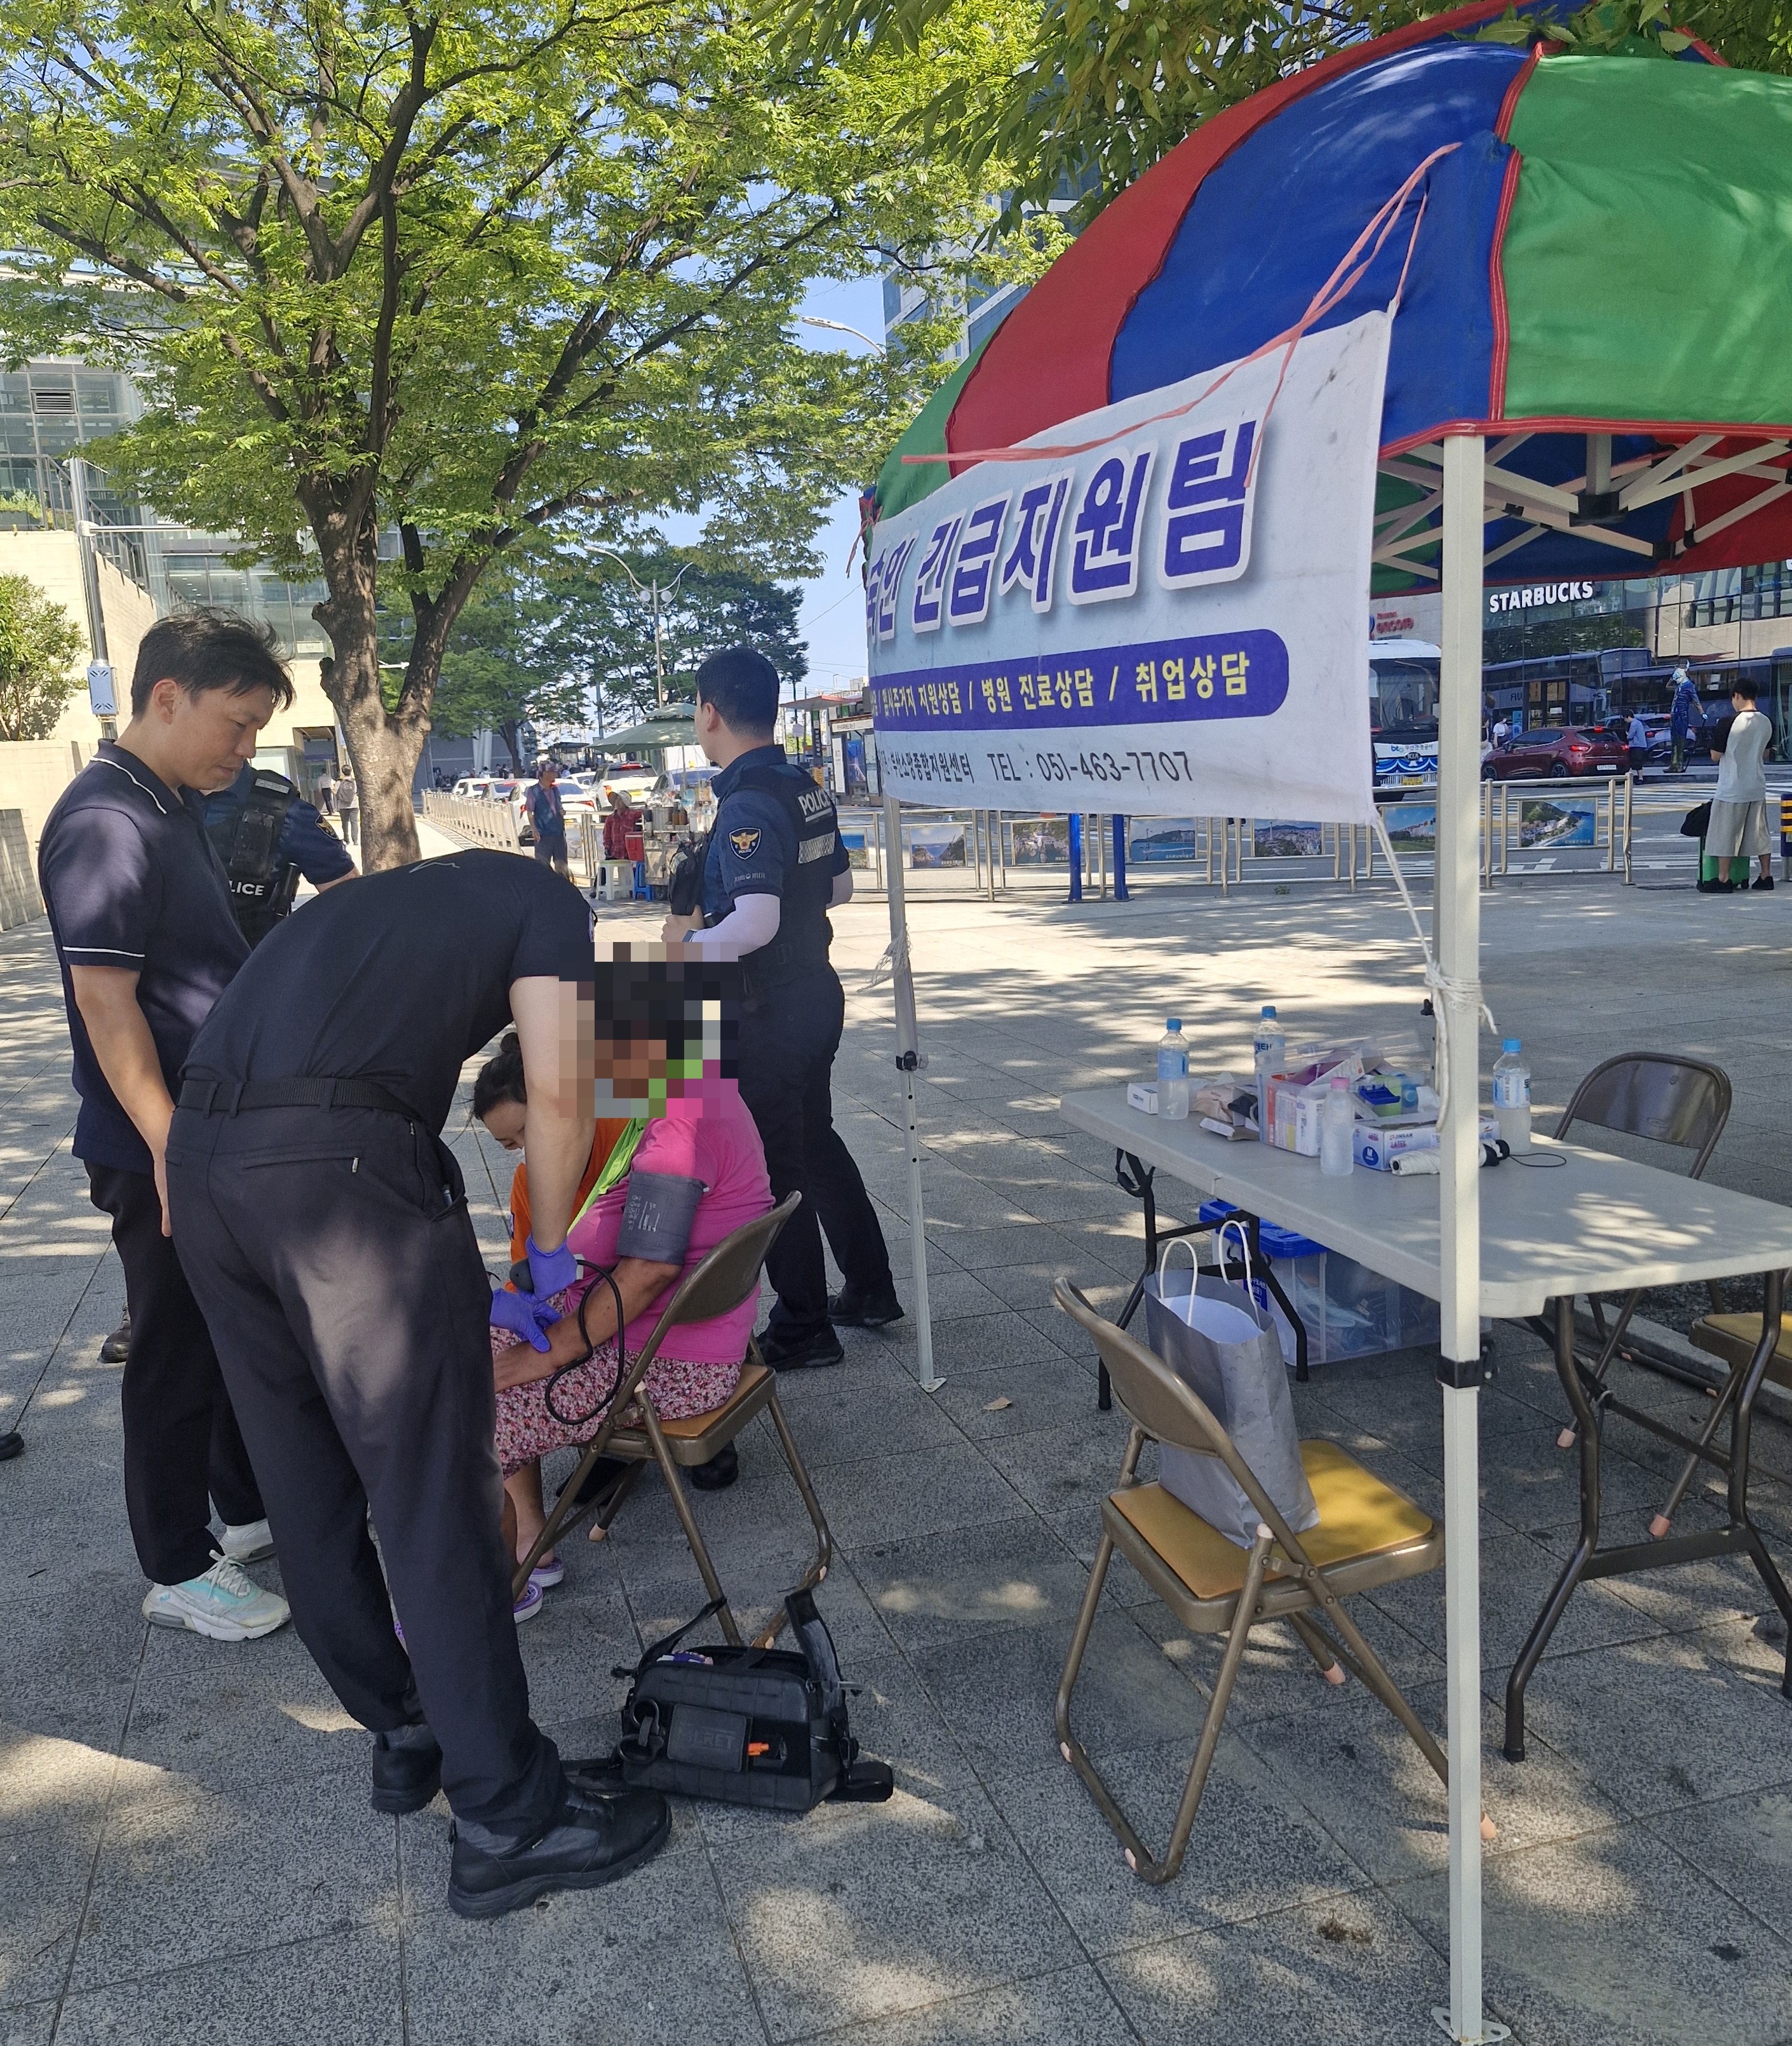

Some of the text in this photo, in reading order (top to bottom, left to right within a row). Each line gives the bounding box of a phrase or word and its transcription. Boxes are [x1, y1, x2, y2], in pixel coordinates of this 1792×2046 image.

[867, 419, 1258, 636] 숙인 긴급지원팀
[1490, 581, 1593, 613] STARBUCKS
[917, 681, 962, 716] 지원상담
[981, 676, 1013, 714] 병원
[1019, 668, 1095, 711] 진료상담
[1108, 665, 1119, 702] /
[1135, 650, 1251, 703] 취업상담
[987, 753, 1021, 782] TEL
[1035, 751, 1194, 782] 051-463-7707
[798, 789, 831, 816] POLICE
[229, 880, 265, 896] LICE
